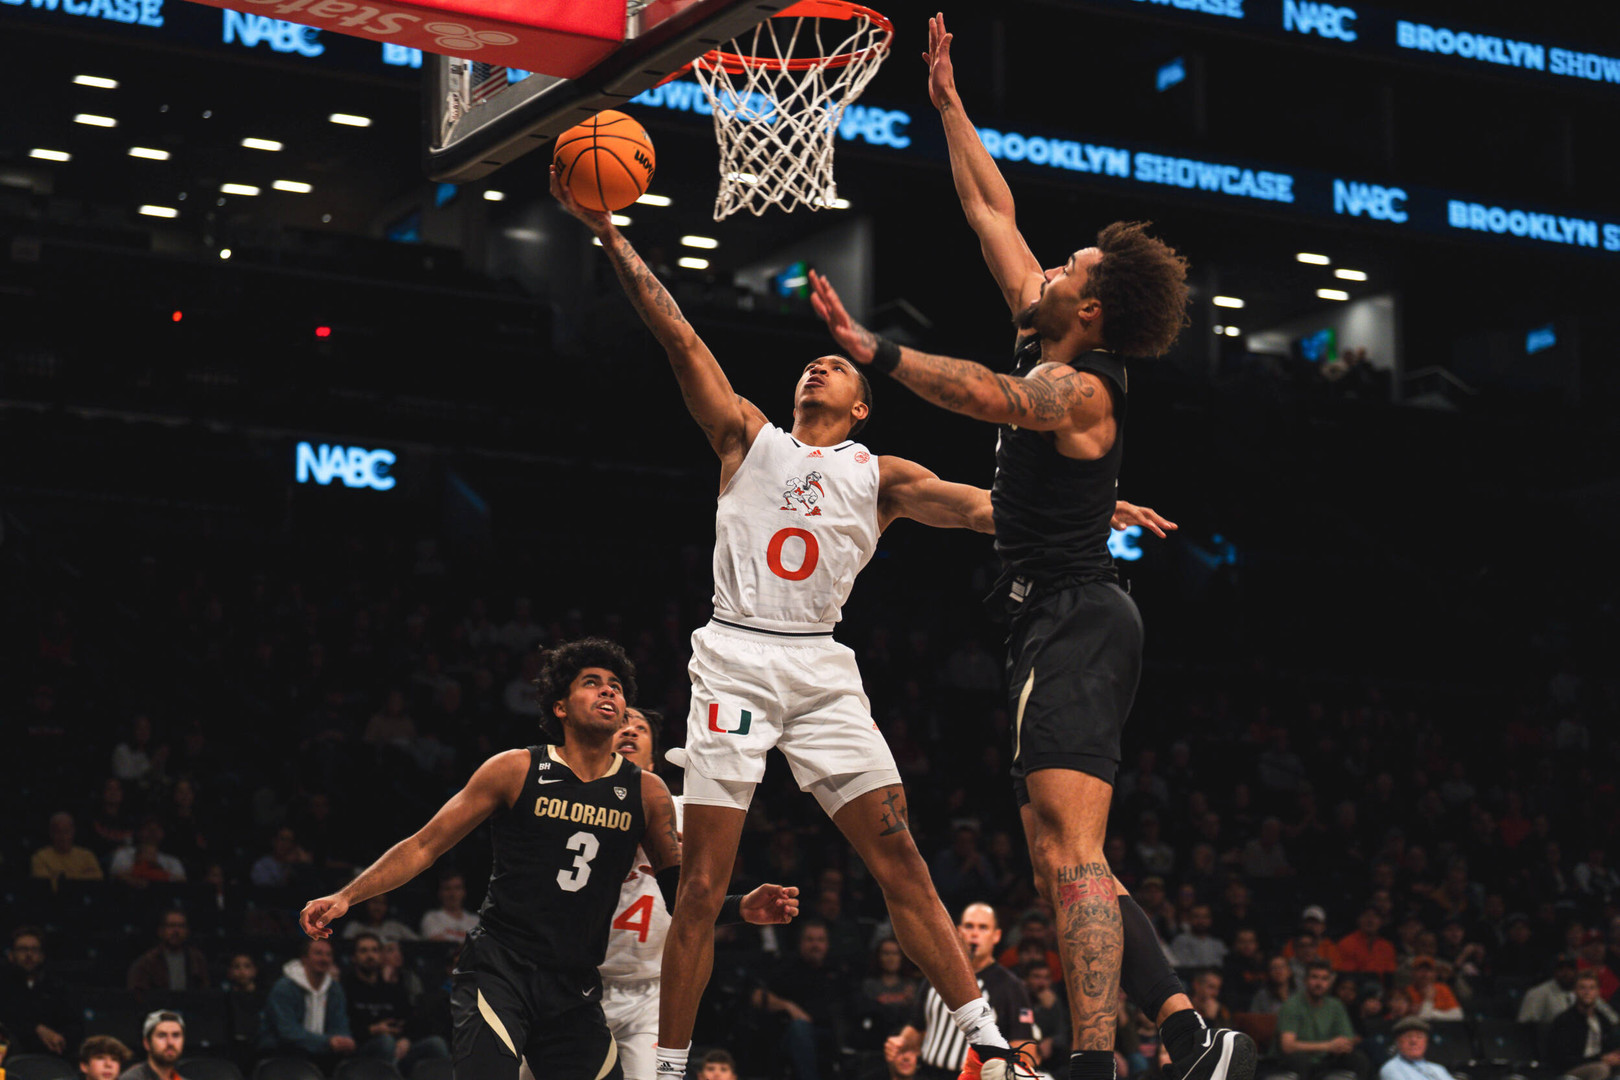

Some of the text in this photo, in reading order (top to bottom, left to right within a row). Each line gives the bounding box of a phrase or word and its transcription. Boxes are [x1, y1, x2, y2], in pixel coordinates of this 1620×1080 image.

[222, 8, 326, 57] NABC
[244, 0, 422, 34] Stat
[1283, 0, 1358, 42] NABC
[1397, 20, 1545, 71] BROOKLYN
[974, 126, 1295, 203] ROOKLYN SHOWCASE
[1333, 178, 1409, 223] NABC
[1447, 199, 1599, 248] BROOKLYN
[296, 440, 397, 491] NABC
[766, 527, 819, 581] 0
[538, 762, 551, 771] BH
[534, 796, 632, 832] COLORADO
[556, 831, 600, 893] 3
[612, 894, 654, 943] 4
